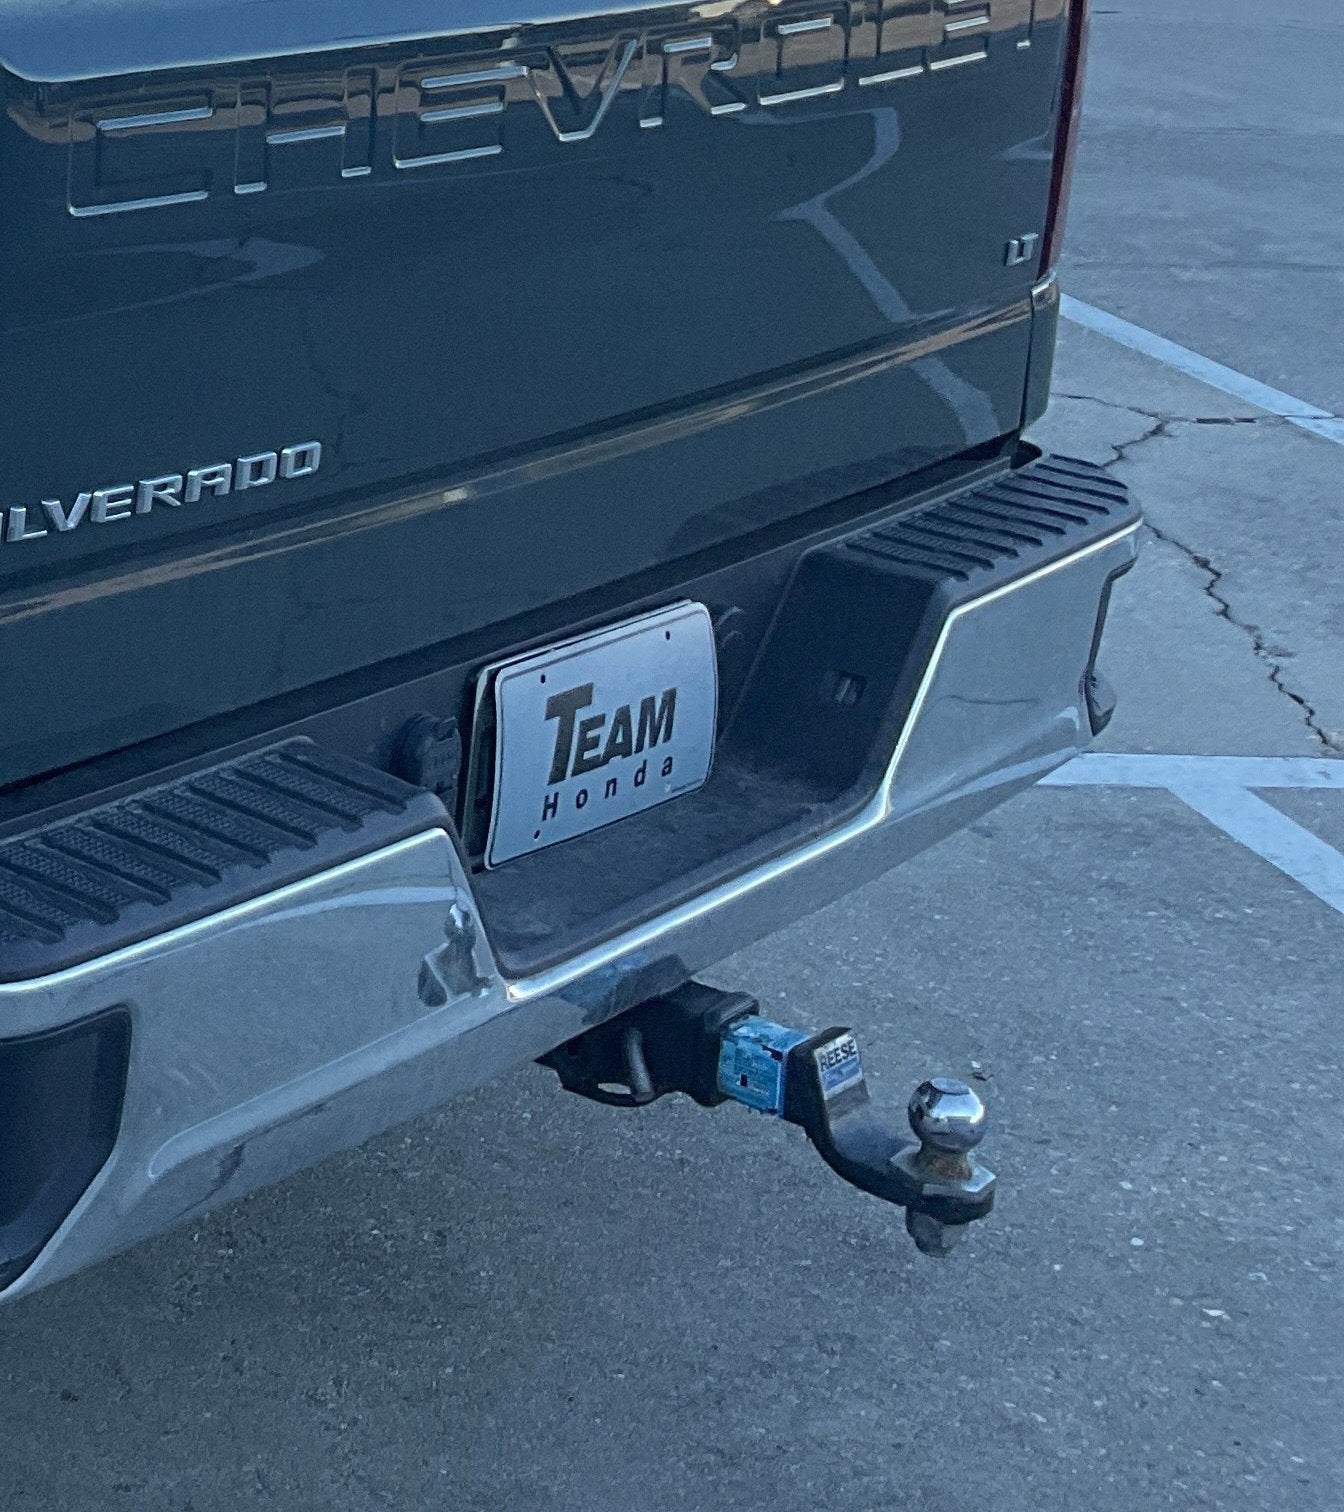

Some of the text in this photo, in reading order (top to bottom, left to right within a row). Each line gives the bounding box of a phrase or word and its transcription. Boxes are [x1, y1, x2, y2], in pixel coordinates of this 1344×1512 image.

[543, 681, 677, 787] TEAM
[540, 752, 675, 823] Honda
[819, 1038, 858, 1073] REESE
